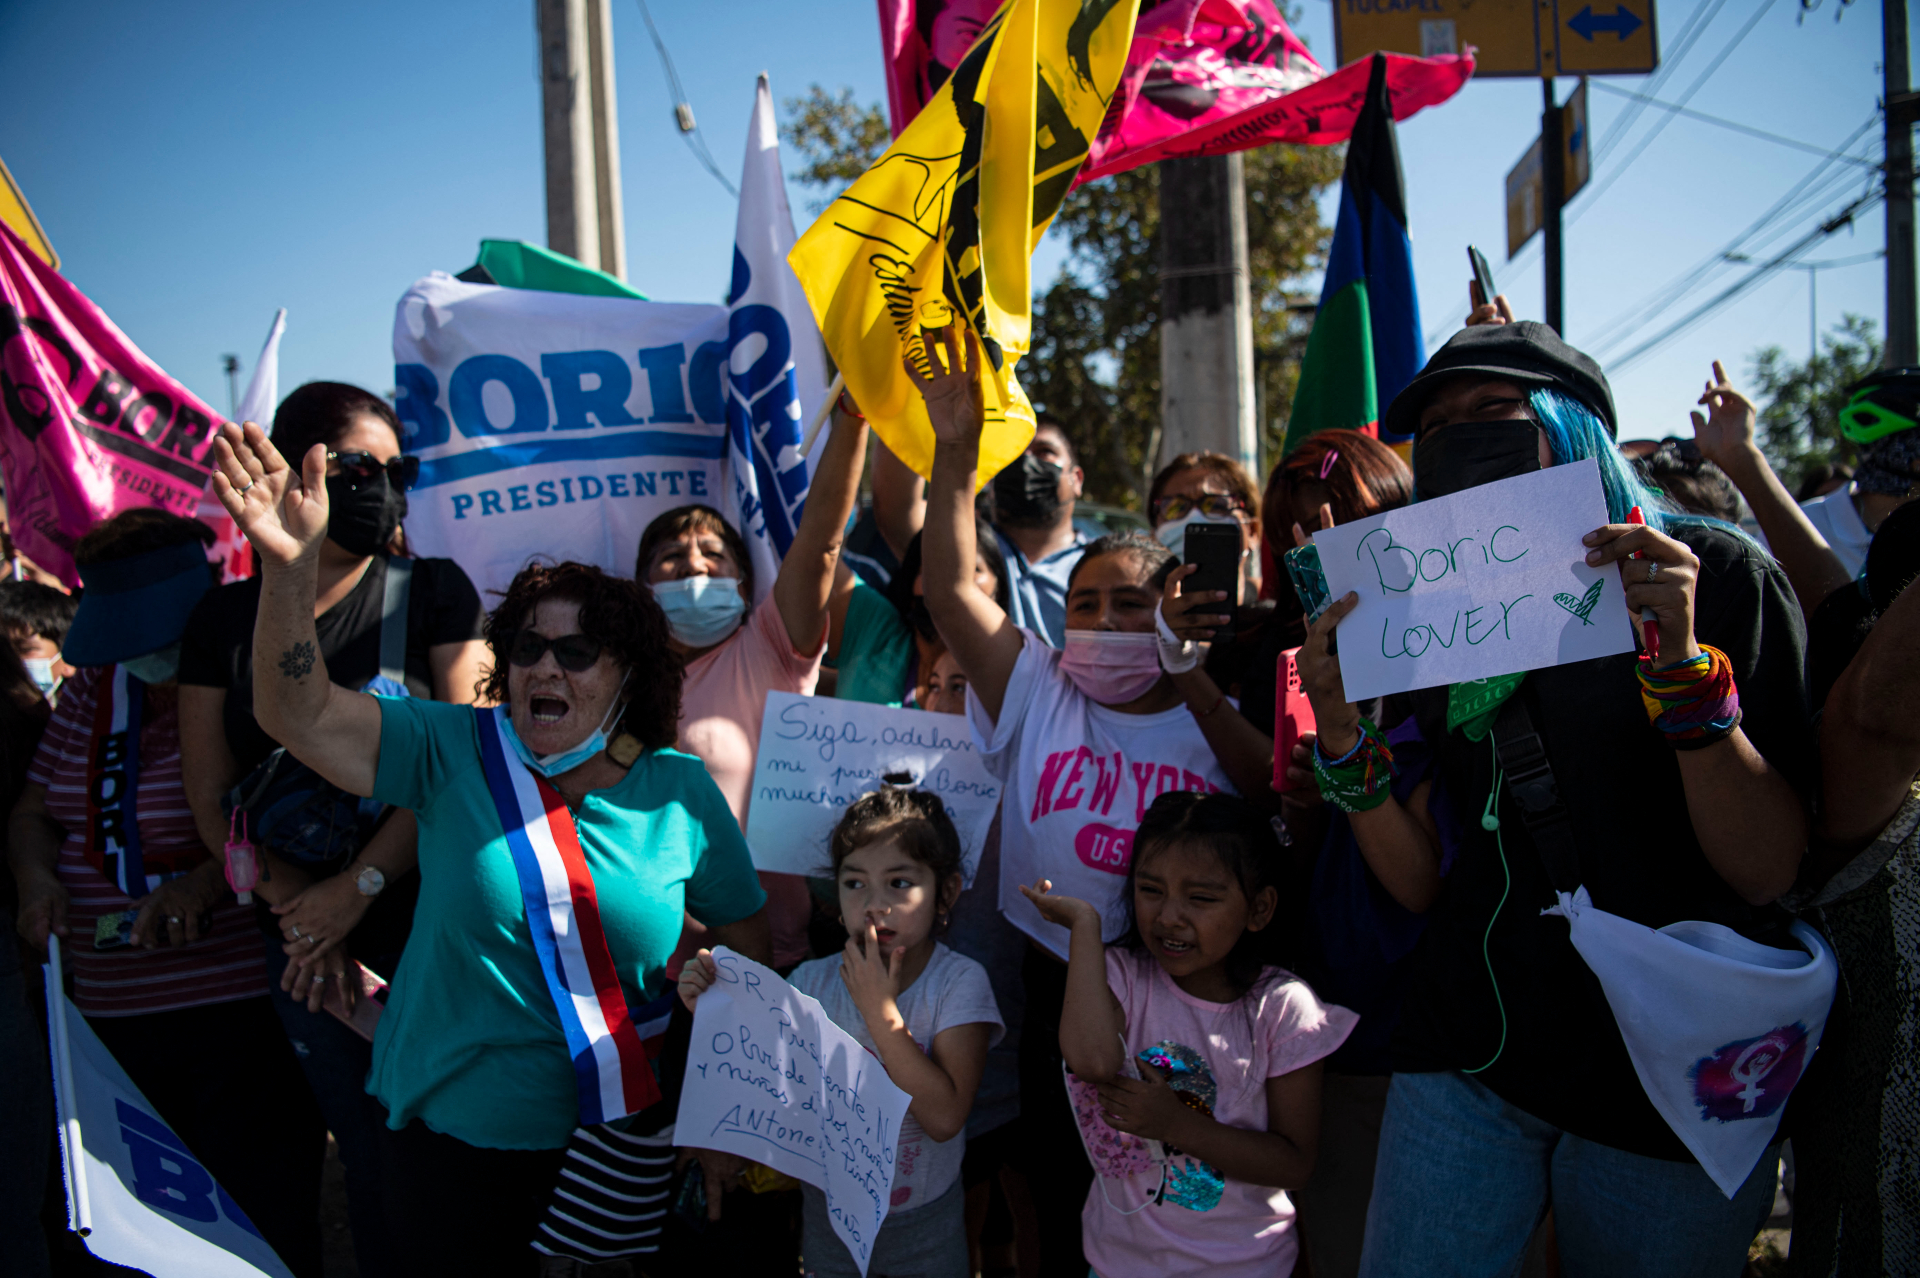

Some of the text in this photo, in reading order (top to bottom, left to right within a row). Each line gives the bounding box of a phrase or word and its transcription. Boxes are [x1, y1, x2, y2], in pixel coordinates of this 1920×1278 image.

[451, 470, 708, 519] PRESIDENTE
[881, 727, 976, 751] adelan
[1030, 745, 1122, 824] NEW
